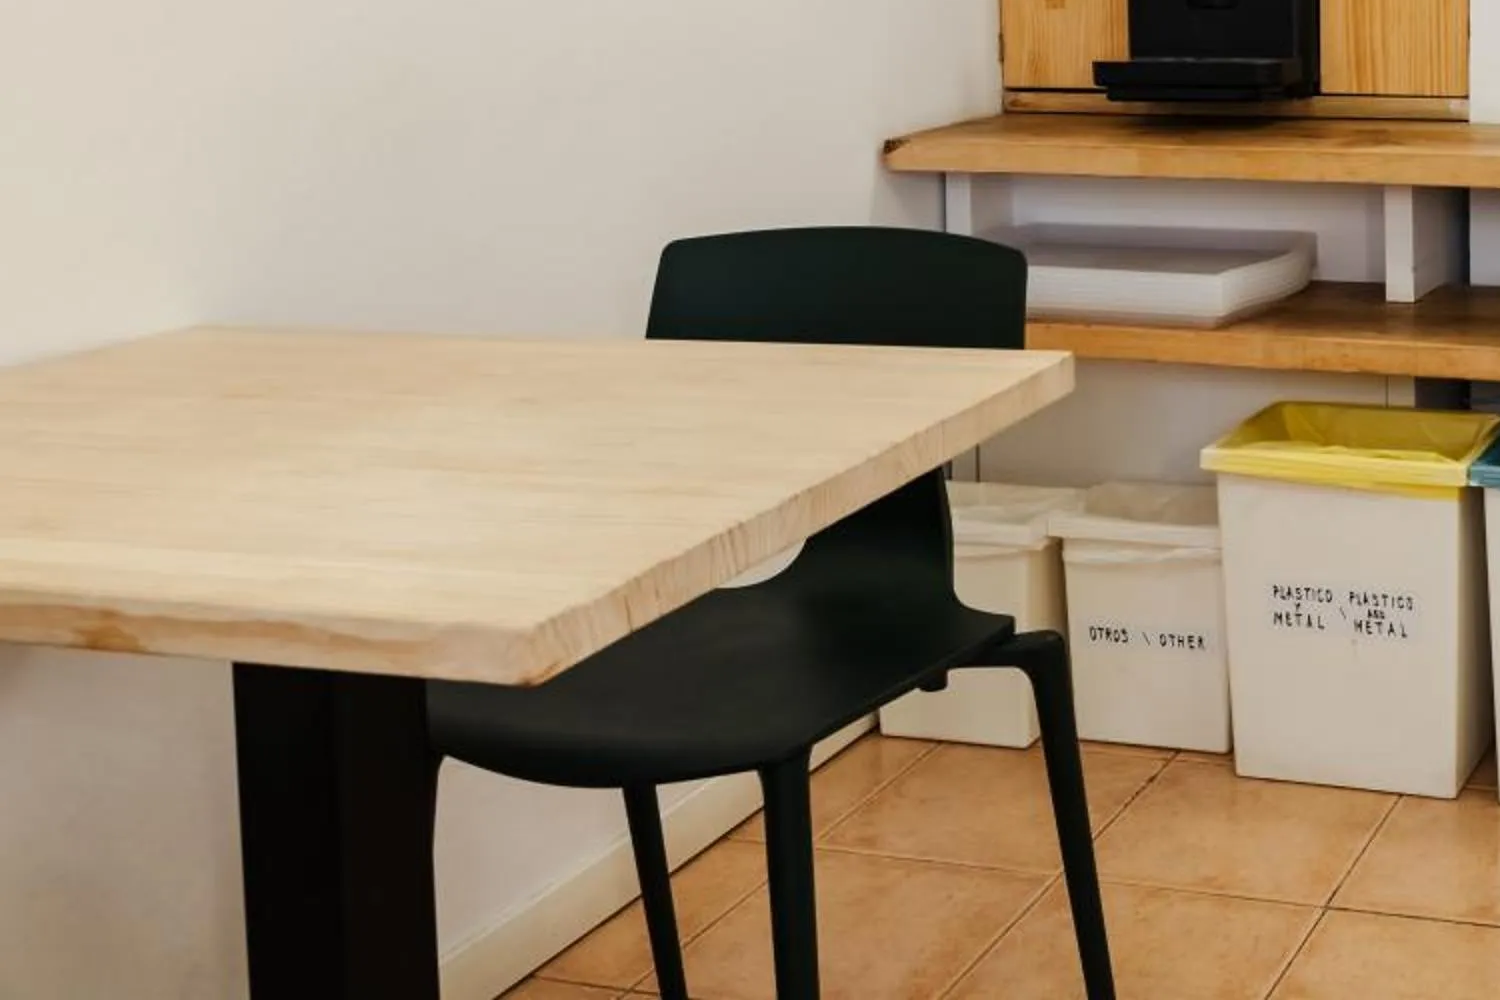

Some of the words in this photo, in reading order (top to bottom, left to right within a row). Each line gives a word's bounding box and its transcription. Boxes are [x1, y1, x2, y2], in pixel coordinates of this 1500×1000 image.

[1273, 585, 1333, 603] PLASTICO
[1273, 611, 1325, 630] METAL
[1354, 619, 1407, 638] METAL
[1089, 626, 1129, 643] OTROS
[1159, 633, 1205, 650] OTHER
